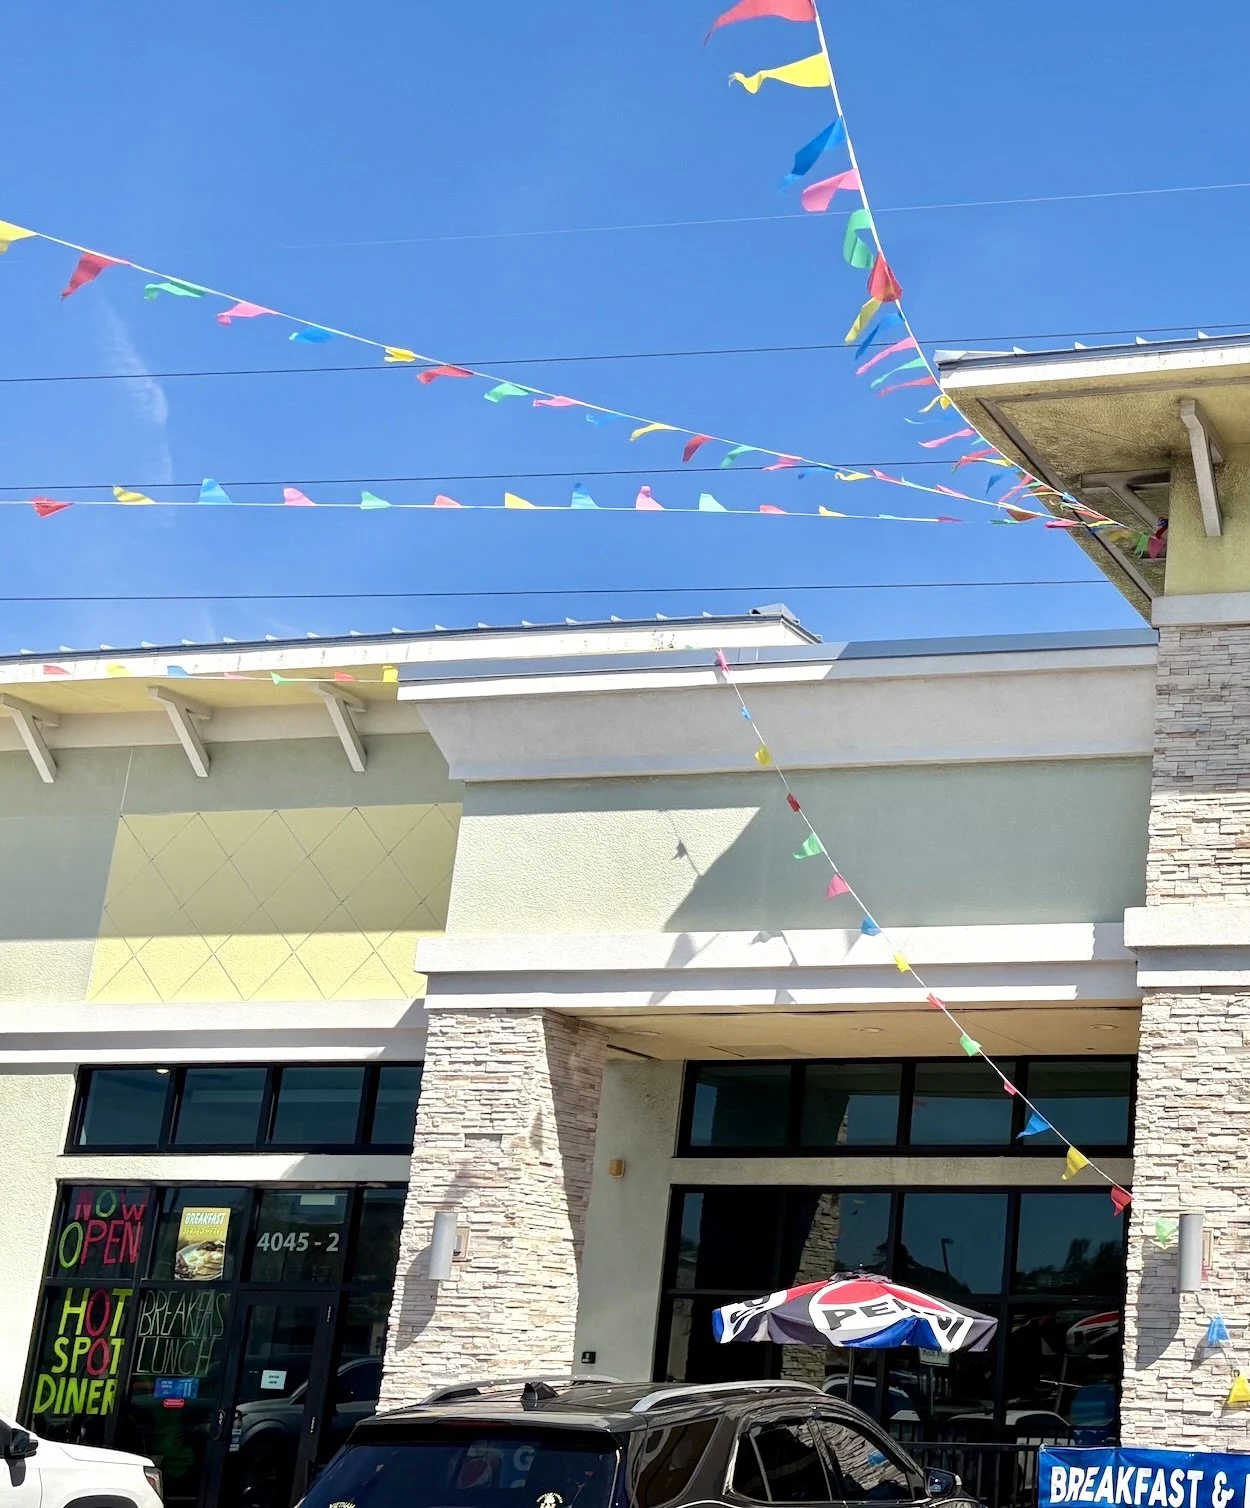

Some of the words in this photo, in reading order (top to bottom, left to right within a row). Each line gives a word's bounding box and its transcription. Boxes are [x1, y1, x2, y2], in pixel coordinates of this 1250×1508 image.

[74, 1190, 150, 1220] NOW
[184, 1212, 226, 1225] BREAKFAST
[59, 1219, 142, 1268] OPEN
[257, 1232, 310, 1252] 4045
[326, 1232, 340, 1252] 2
[58, 1287, 134, 1337] HOT
[138, 1289, 232, 1337] BREAKFAS
[51, 1336, 125, 1376] SPOT
[136, 1336, 216, 1376] LUNCH
[33, 1373, 119, 1415] DINER
[1050, 1465, 1204, 1508] BREAKFAST
[1211, 1471, 1234, 1508] &
